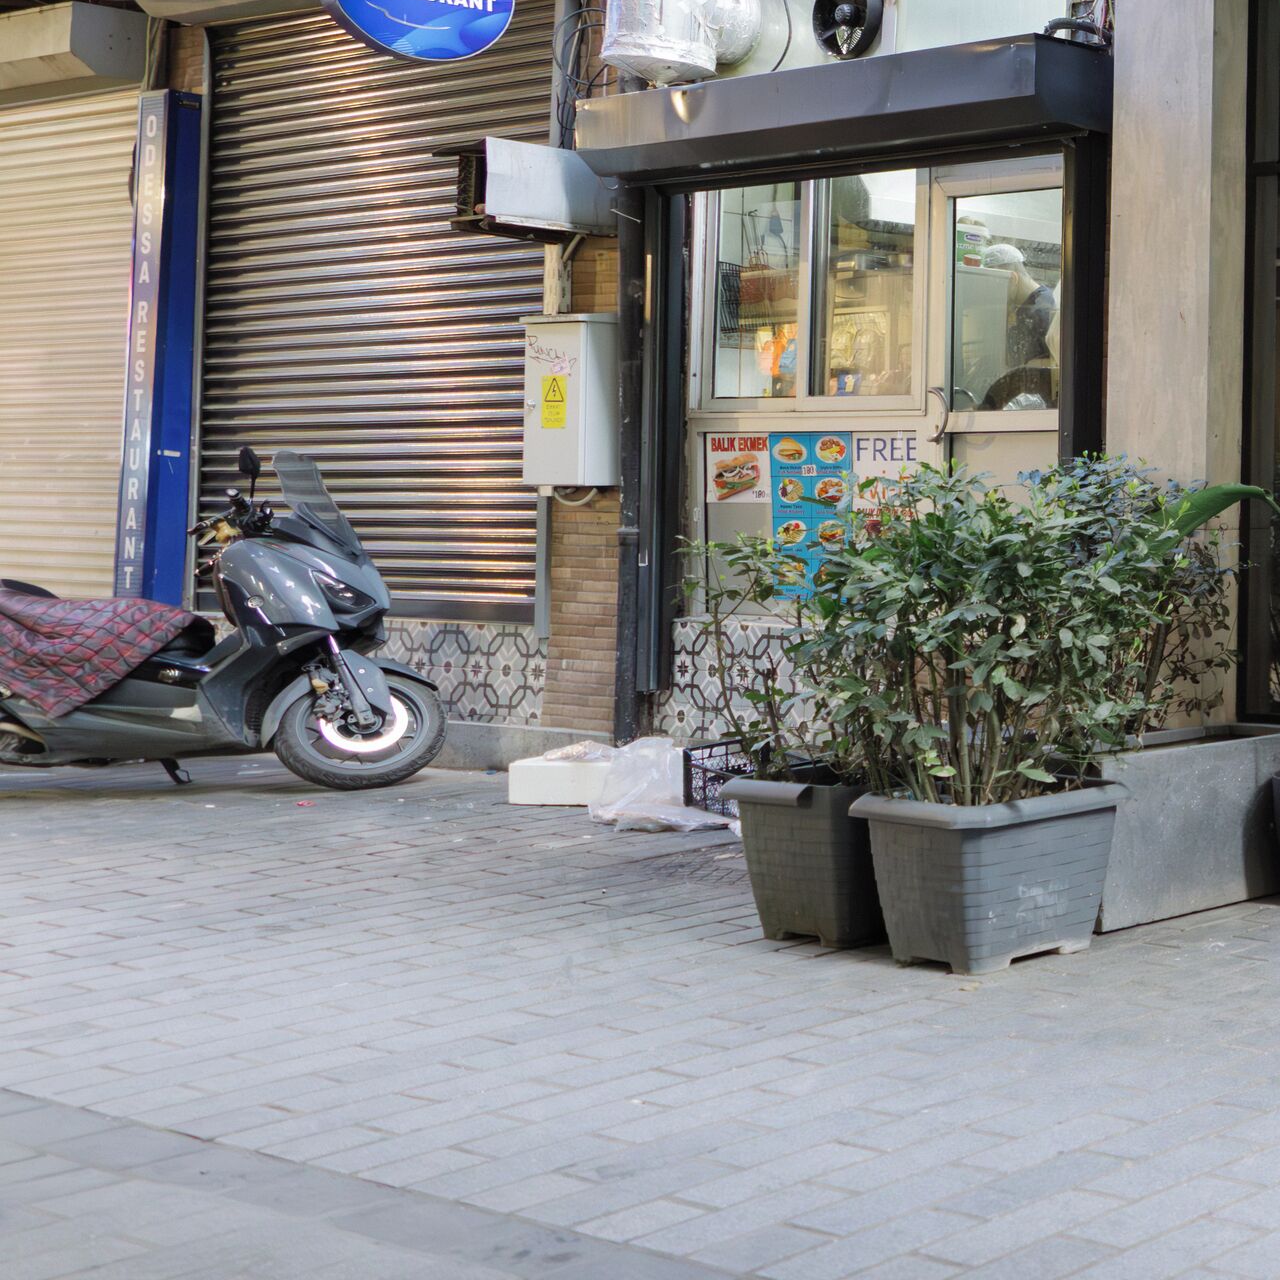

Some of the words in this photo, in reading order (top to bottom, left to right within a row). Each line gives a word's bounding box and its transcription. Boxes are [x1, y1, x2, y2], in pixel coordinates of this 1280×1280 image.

[138, 115, 158, 284] ODESSA
[124, 301, 149, 588] RESTAURANT
[711, 437, 736, 452] BALIK
[738, 436, 769, 451] EKMEK
[856, 437, 917, 462] FREE
